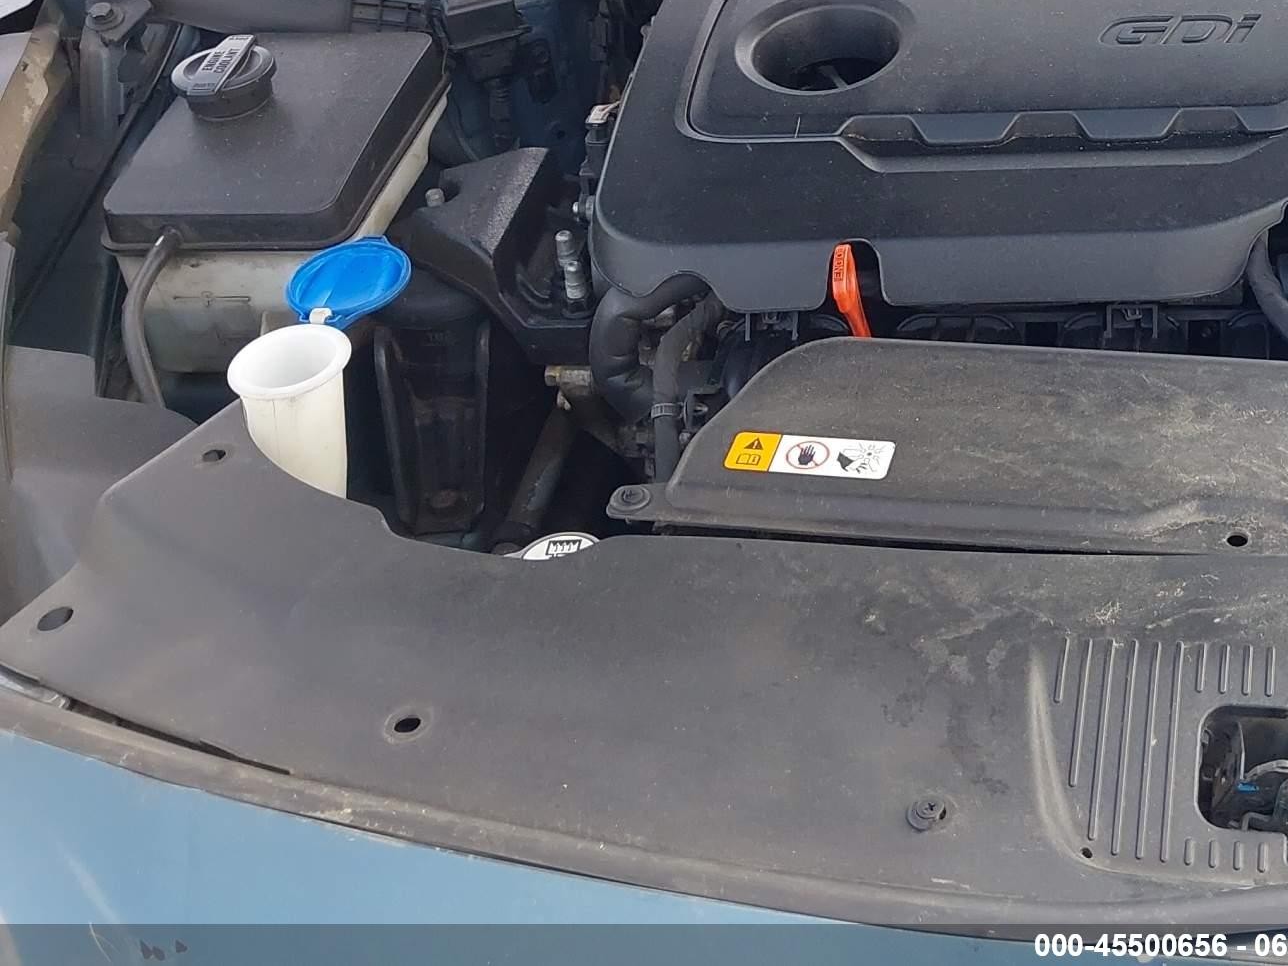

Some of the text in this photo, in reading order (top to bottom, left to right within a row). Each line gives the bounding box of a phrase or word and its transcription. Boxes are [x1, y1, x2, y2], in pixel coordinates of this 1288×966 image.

[1099, 13, 1262, 45] GDi
[201, 51, 225, 71] ENGINE
[213, 48, 241, 74] COOLANT
